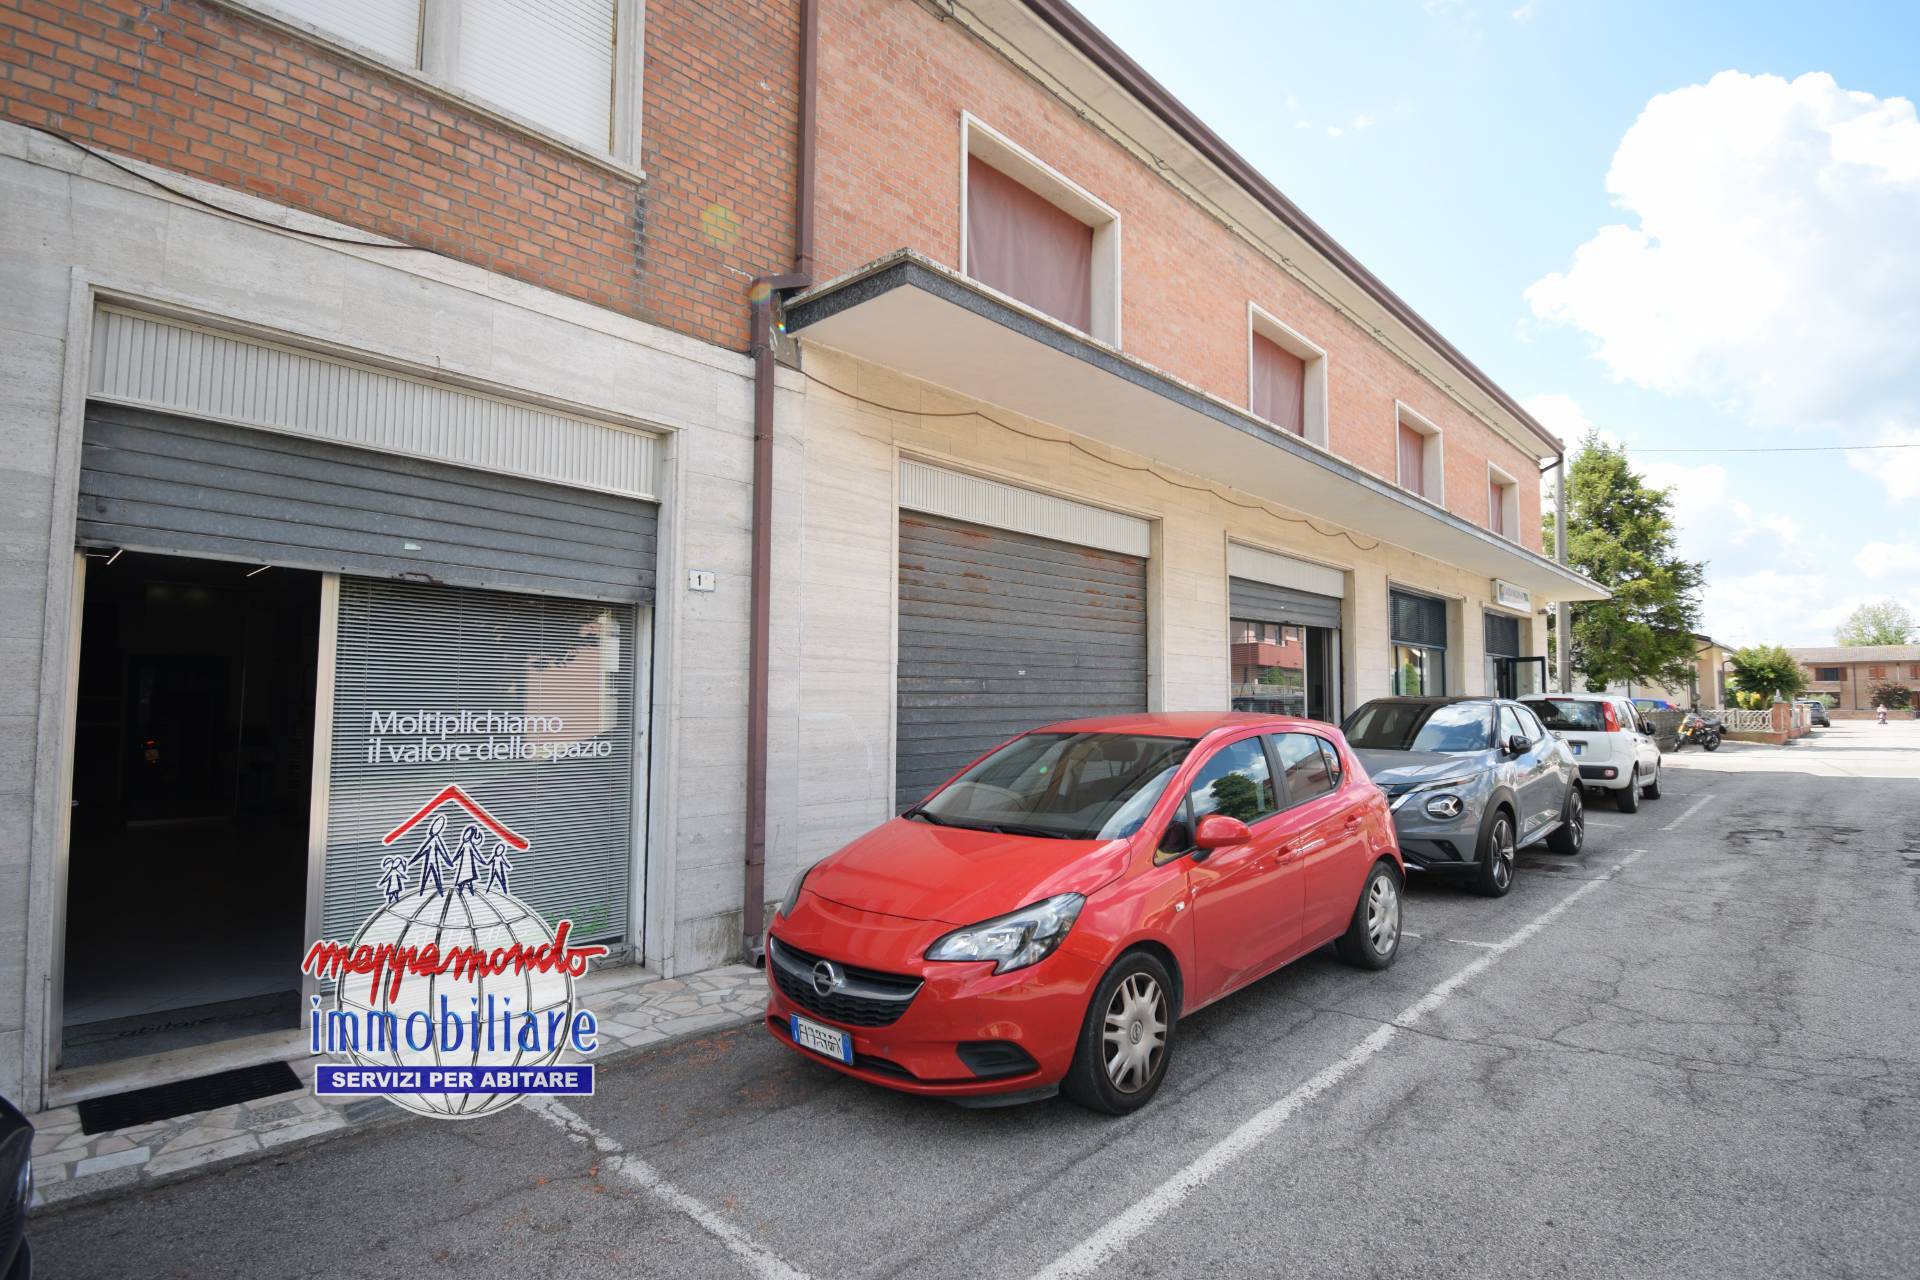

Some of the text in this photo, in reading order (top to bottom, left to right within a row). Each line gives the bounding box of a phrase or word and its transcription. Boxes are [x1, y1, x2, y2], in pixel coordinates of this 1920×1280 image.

[369, 709, 564, 741] Moltiplichiamo
[367, 735, 612, 764] il valore dello spazio
